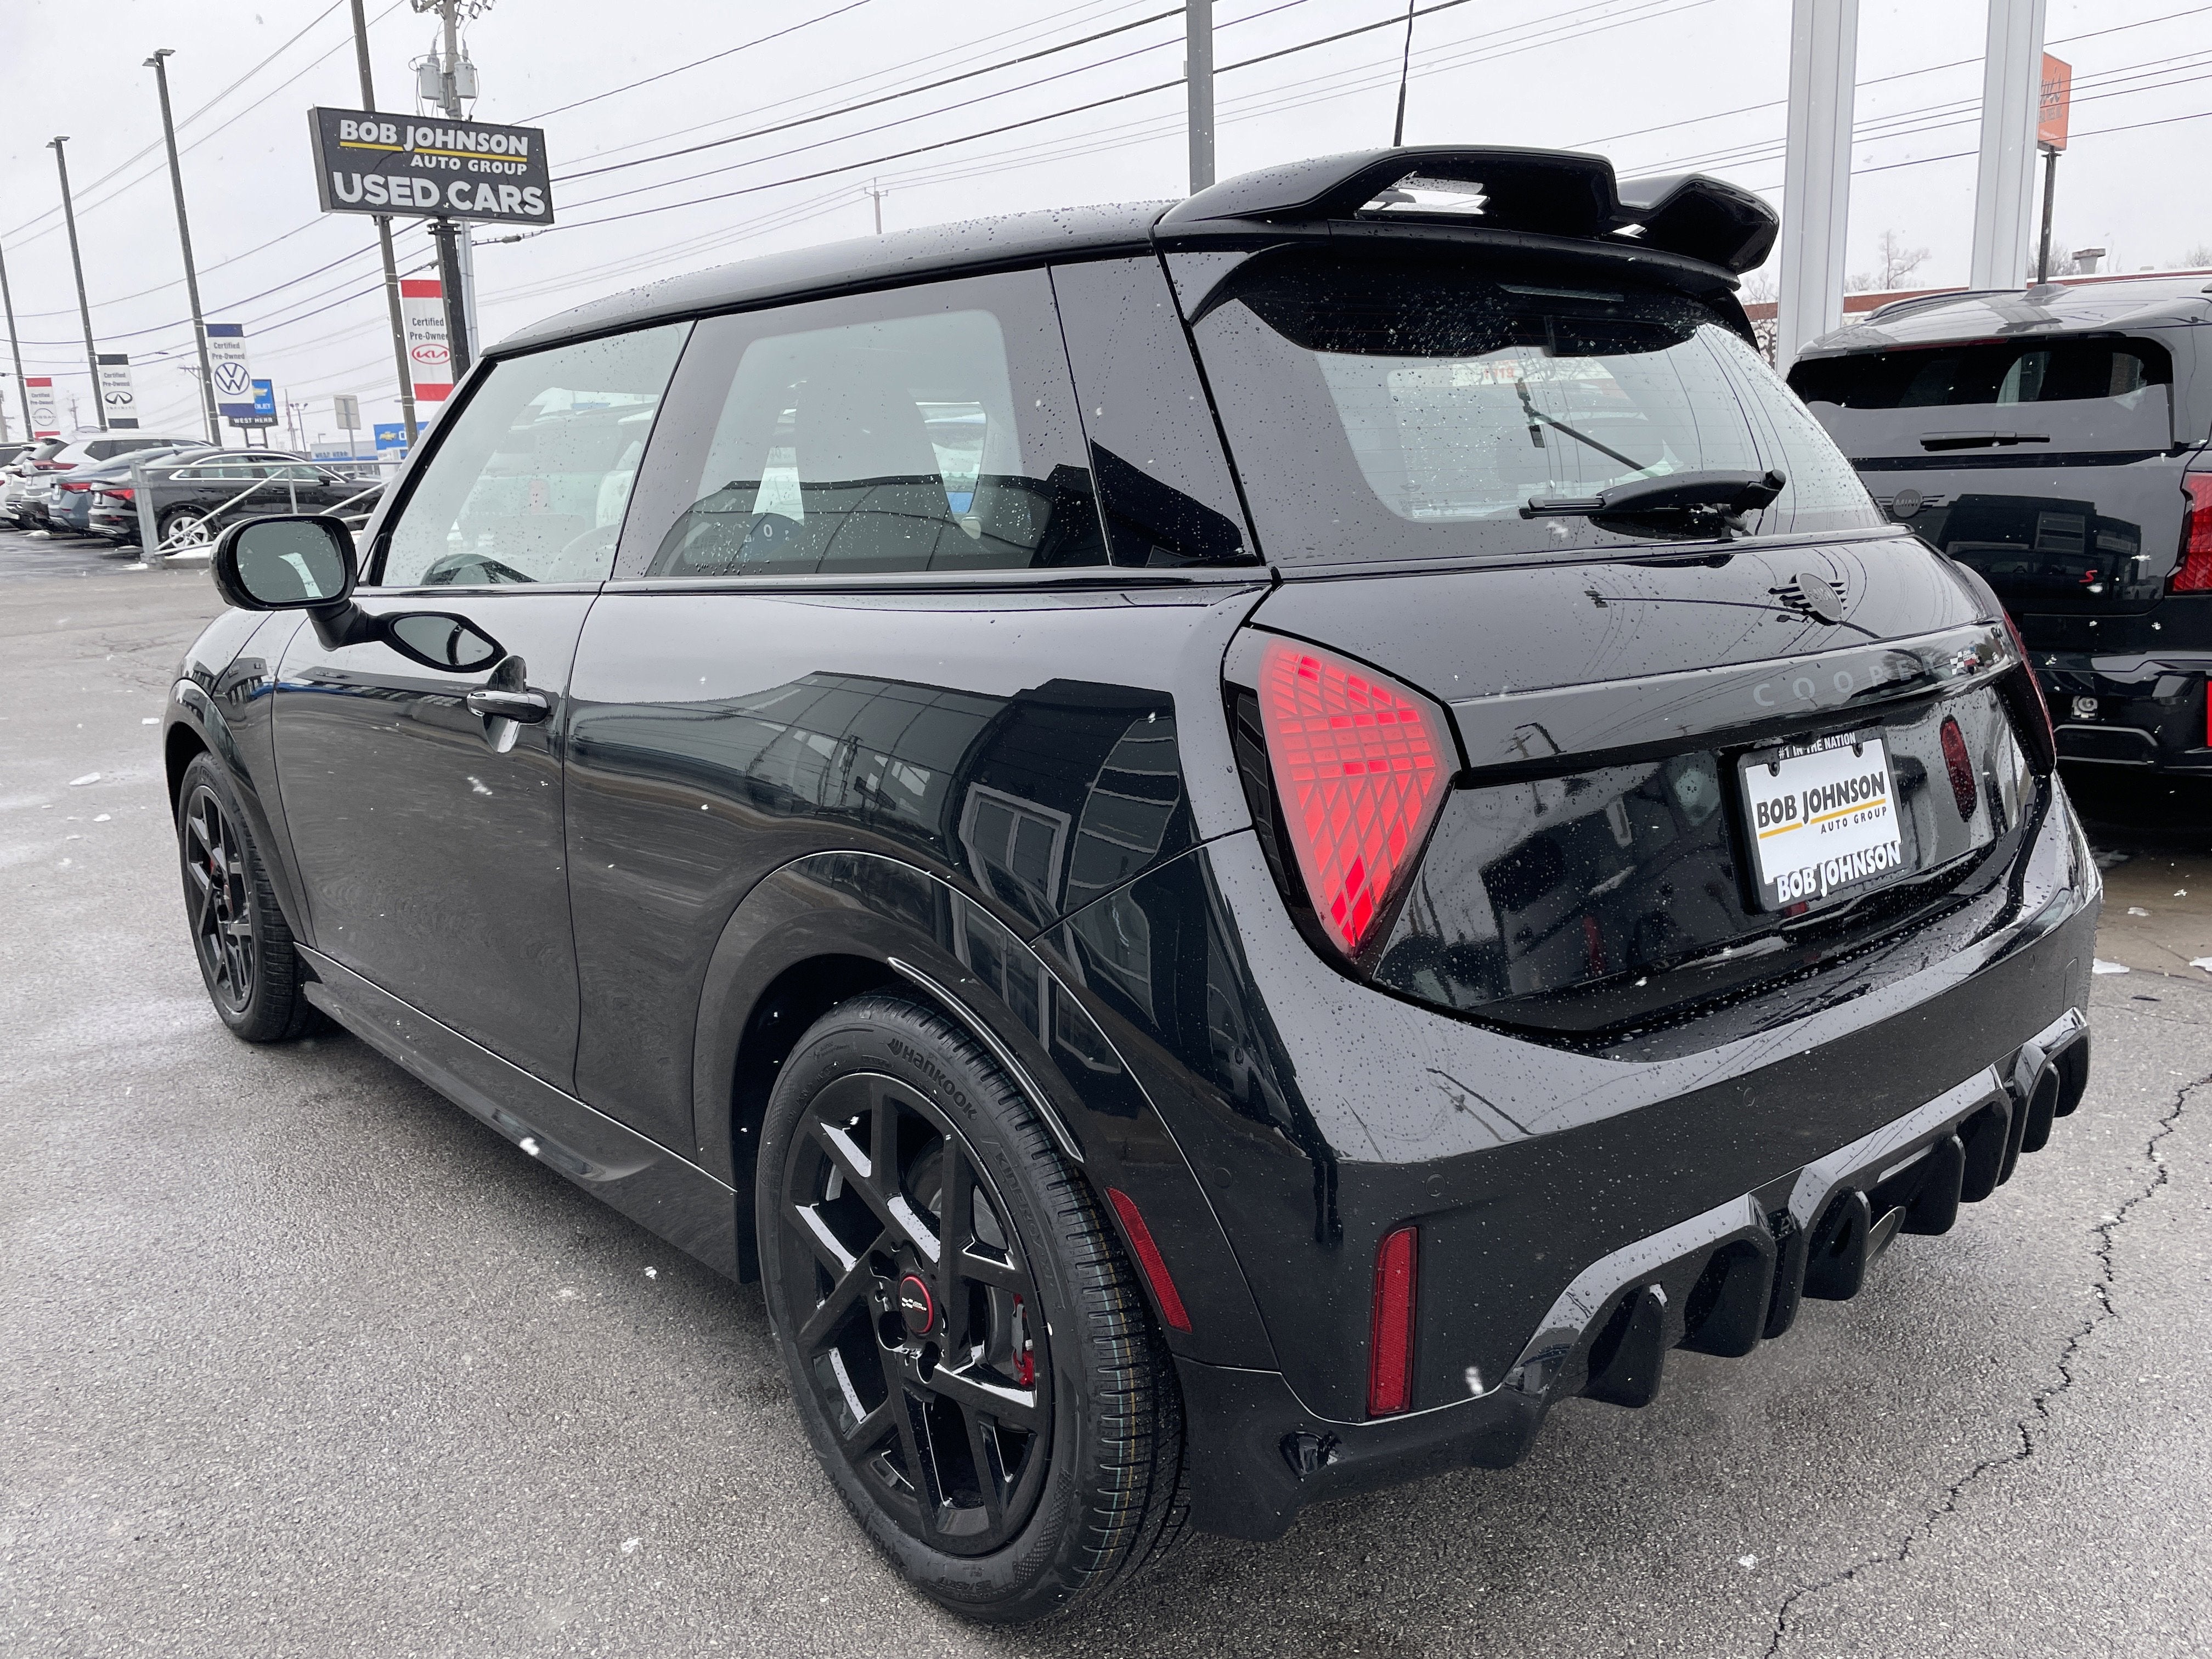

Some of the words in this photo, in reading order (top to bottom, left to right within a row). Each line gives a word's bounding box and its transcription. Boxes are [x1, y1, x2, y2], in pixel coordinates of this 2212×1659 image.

[340, 120, 397, 143] BOB
[403, 126, 528, 156] JOHNSON
[410, 154, 460, 171] AUTO
[467, 160, 527, 176] GROUP
[333, 172, 440, 208] USED
[447, 181, 545, 216] CARS
[413, 318, 444, 326] Certified
[2078, 569, 2098, 583] S
[1778, 746, 1790, 760] #1
[1824, 731, 1857, 750] NATION
[1756, 794, 1797, 828] BOB
[1802, 771, 1886, 825] JOHNSON
[1821, 817, 1848, 834] AUTO
[1854, 806, 1887, 825] GROUP
[1776, 866, 1816, 903] BOB
[1820, 841, 1901, 898] JOHNSON
